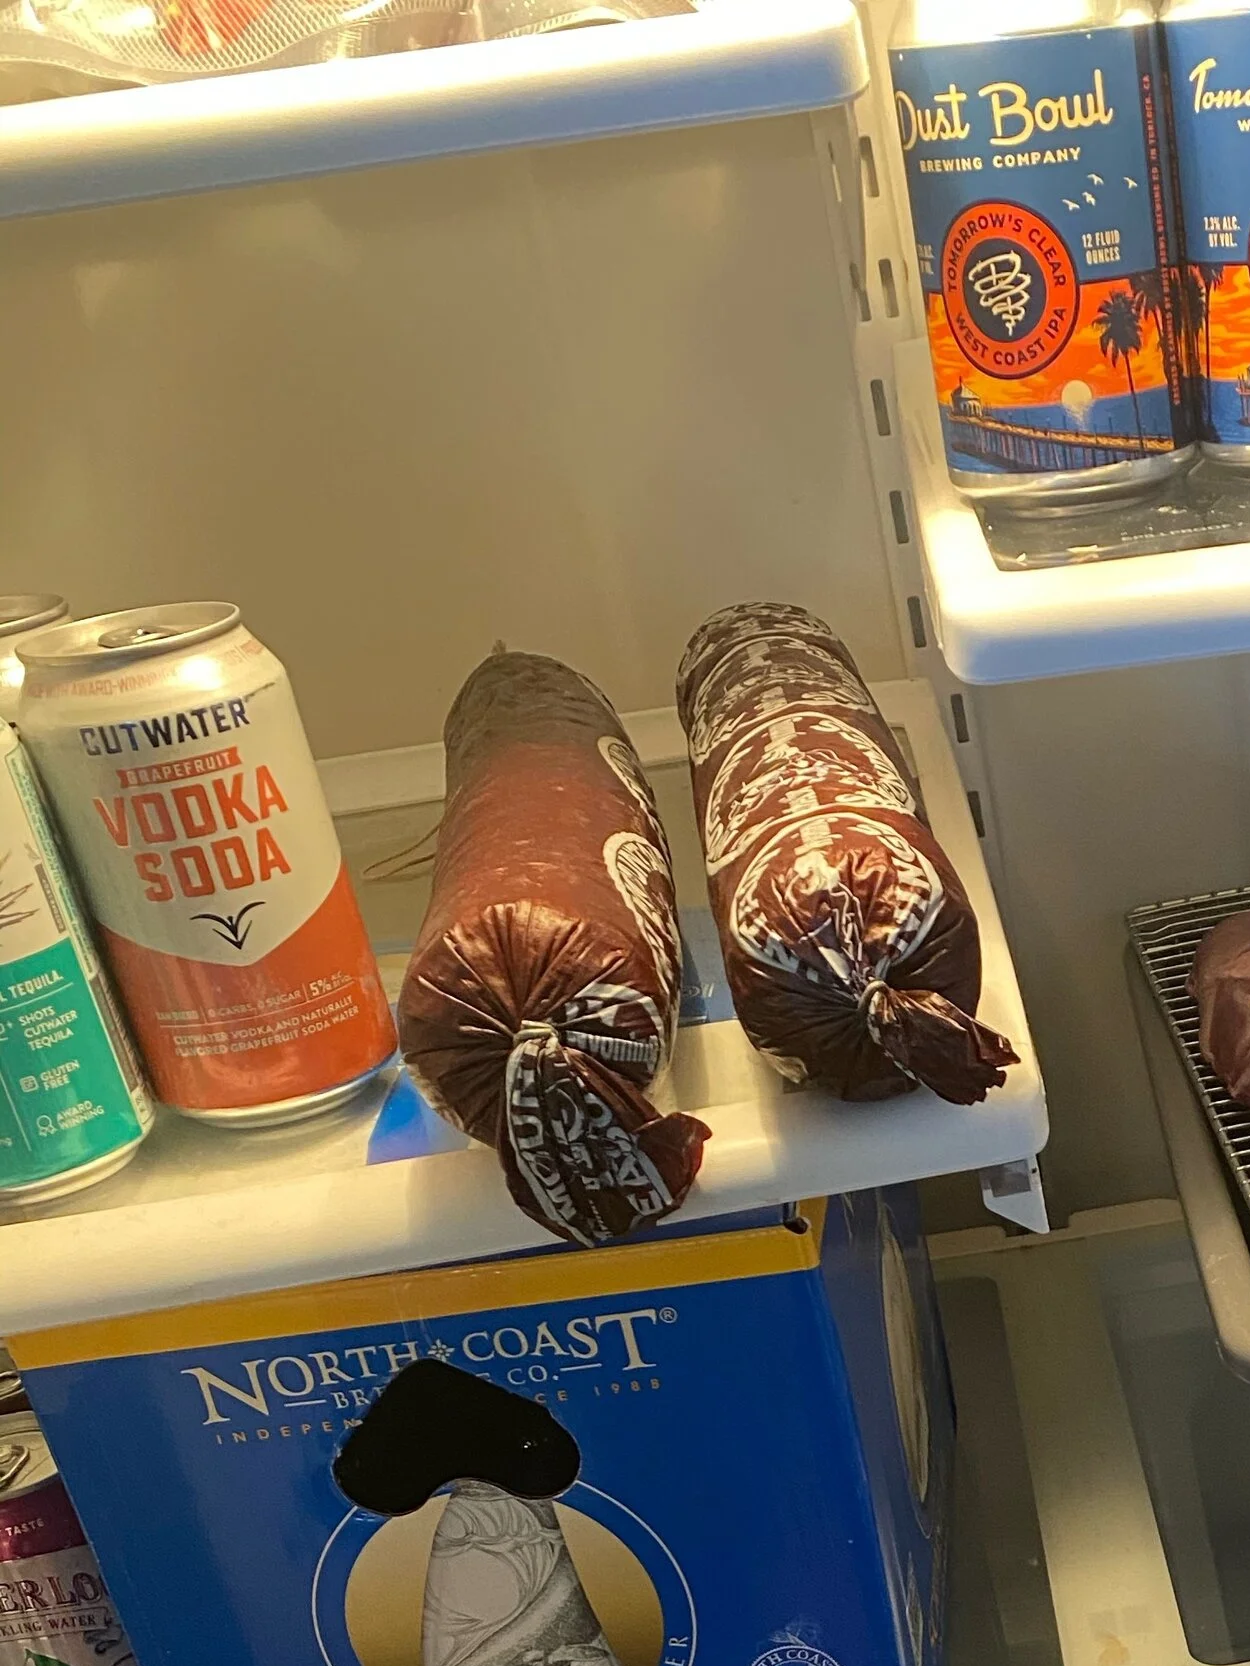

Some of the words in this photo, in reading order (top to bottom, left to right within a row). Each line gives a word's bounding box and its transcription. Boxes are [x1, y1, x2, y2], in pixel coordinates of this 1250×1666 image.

[895, 84, 970, 150] Dust
[978, 69, 1113, 145] Bowl
[920, 157, 983, 172] BREWING
[993, 147, 1081, 168] COMPANY
[1223, 215, 1241, 231] ALC.
[1082, 233, 1092, 248] 12
[1096, 229, 1120, 246] FLUID
[1219, 232, 1238, 247] VOL.
[948, 213, 1023, 292] TOMORROW'S
[1028, 228, 1066, 287] CLEAR
[1086, 247, 1120, 265] OUNCES
[956, 313, 989, 358] WEST
[993, 339, 1046, 366] COAST
[1045, 307, 1066, 339] IPA
[80, 698, 250, 756] CUTWATER
[126, 752, 231, 787] GRAPEFRUIT
[92, 765, 288, 848] VODKA
[134, 827, 292, 902] SODA
[266, 990, 302, 1007] SUGAR
[308, 979, 331, 997] 5%
[19, 1005, 55, 1027] SHOTS
[24, 1009, 78, 1038] CUTWATER
[173, 1031, 228, 1045] CUTWATER
[232, 1026, 273, 1040] VODKA
[273, 1017, 300, 1032] AND
[301, 995, 353, 1023] NATURALLY
[28, 1028, 75, 1051] TEQUILA
[175, 1044, 228, 1057] FLAVORED
[230, 1030, 299, 1052] GRAPEFRUIT
[301, 1021, 331, 1036] SODA
[331, 1006, 360, 1026] WATER
[40, 1059, 80, 1081] GLUTEN
[43, 1075, 70, 1091] FREE
[56, 1100, 93, 1121] AWARD
[58, 1105, 104, 1130] WINNING
[180, 1341, 418, 1425] NORTH
[507, 1364, 559, 1385] CO.
[593, 1378, 661, 1397] 1988
[5, 1518, 44, 1536] TASTE
[48, 1614, 96, 1630] WATER
